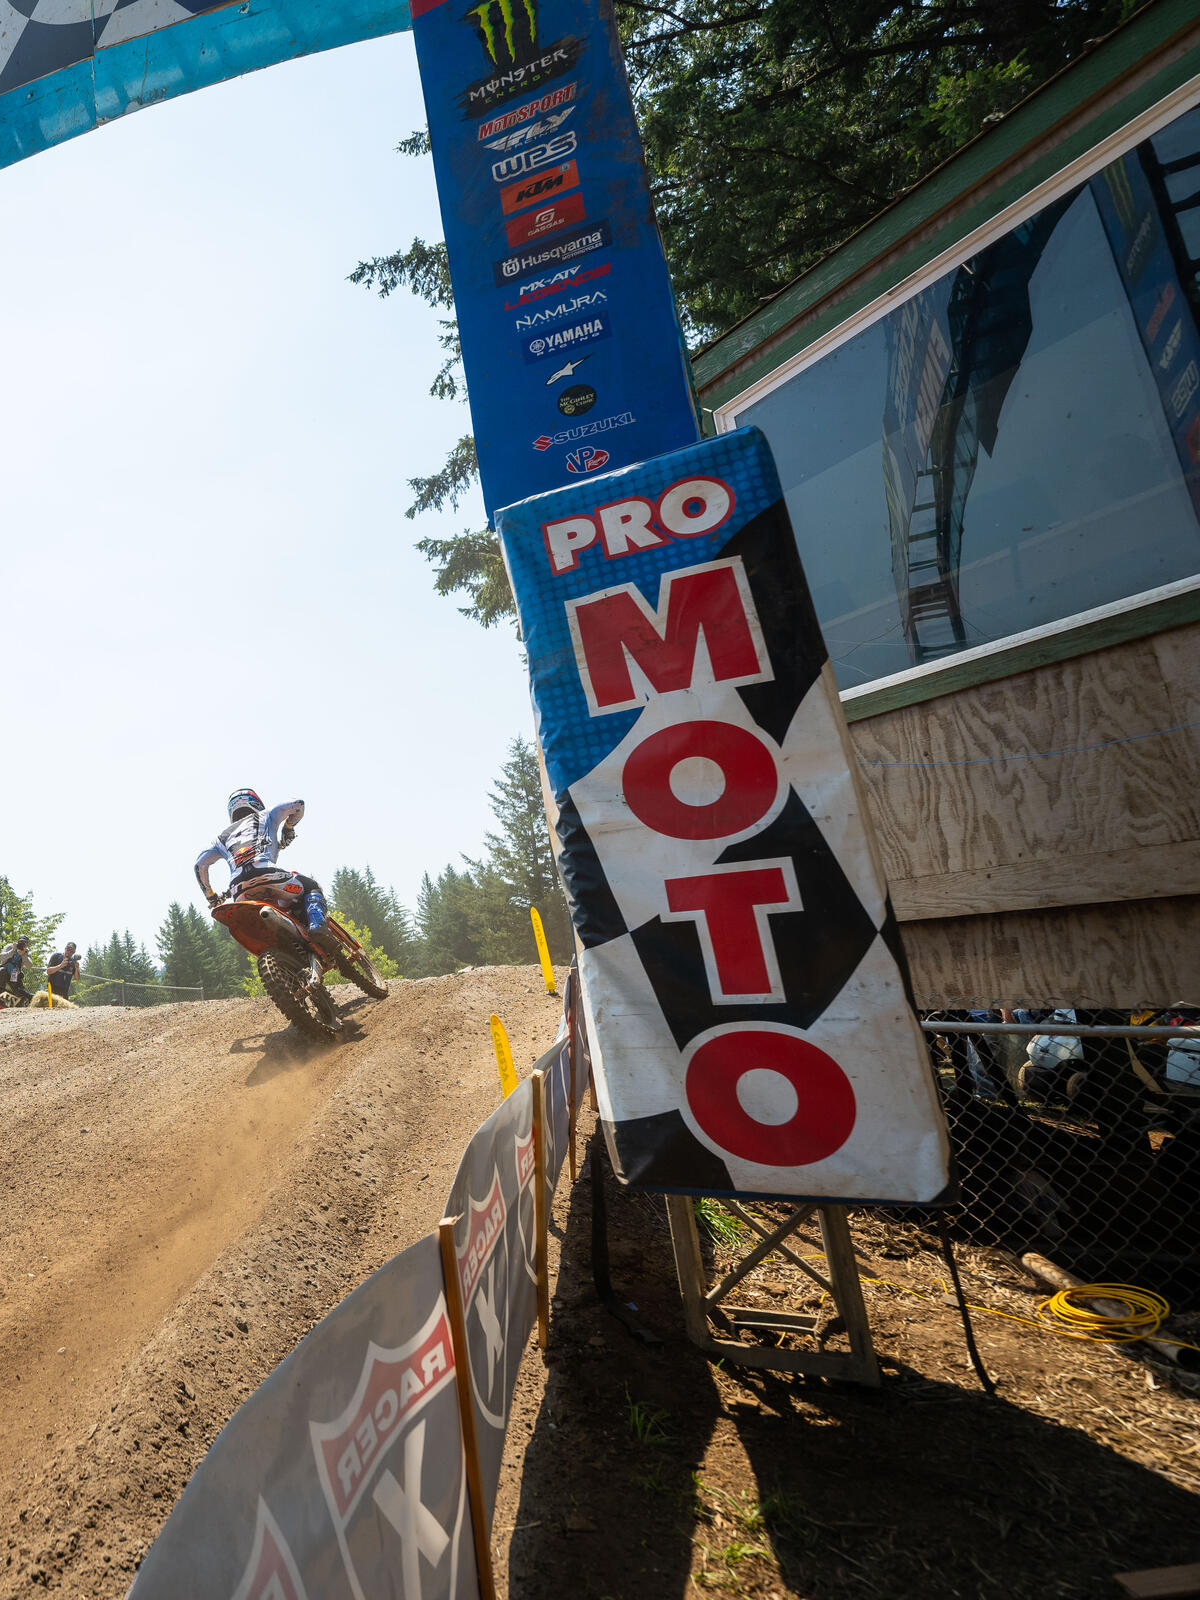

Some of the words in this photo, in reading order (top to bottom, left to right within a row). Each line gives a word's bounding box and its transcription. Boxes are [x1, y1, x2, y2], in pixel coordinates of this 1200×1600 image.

[469, 48, 568, 102] MONSTER
[484, 69, 552, 104] ENERGY
[492, 129, 578, 182] WPS
[515, 173, 564, 204] KTM
[527, 217, 565, 237] GASGAS
[521, 229, 603, 270] Husqvarna
[503, 262, 612, 311] LEGENDS
[519, 264, 581, 296] MX-ATV
[515, 290, 607, 331] NAMURA
[545, 319, 603, 348] YAMAHA
[552, 411, 636, 445] SUZUKI
[565, 445, 596, 473] VP
[541, 475, 736, 577] PRO
[564, 554, 858, 1168] MOTO
